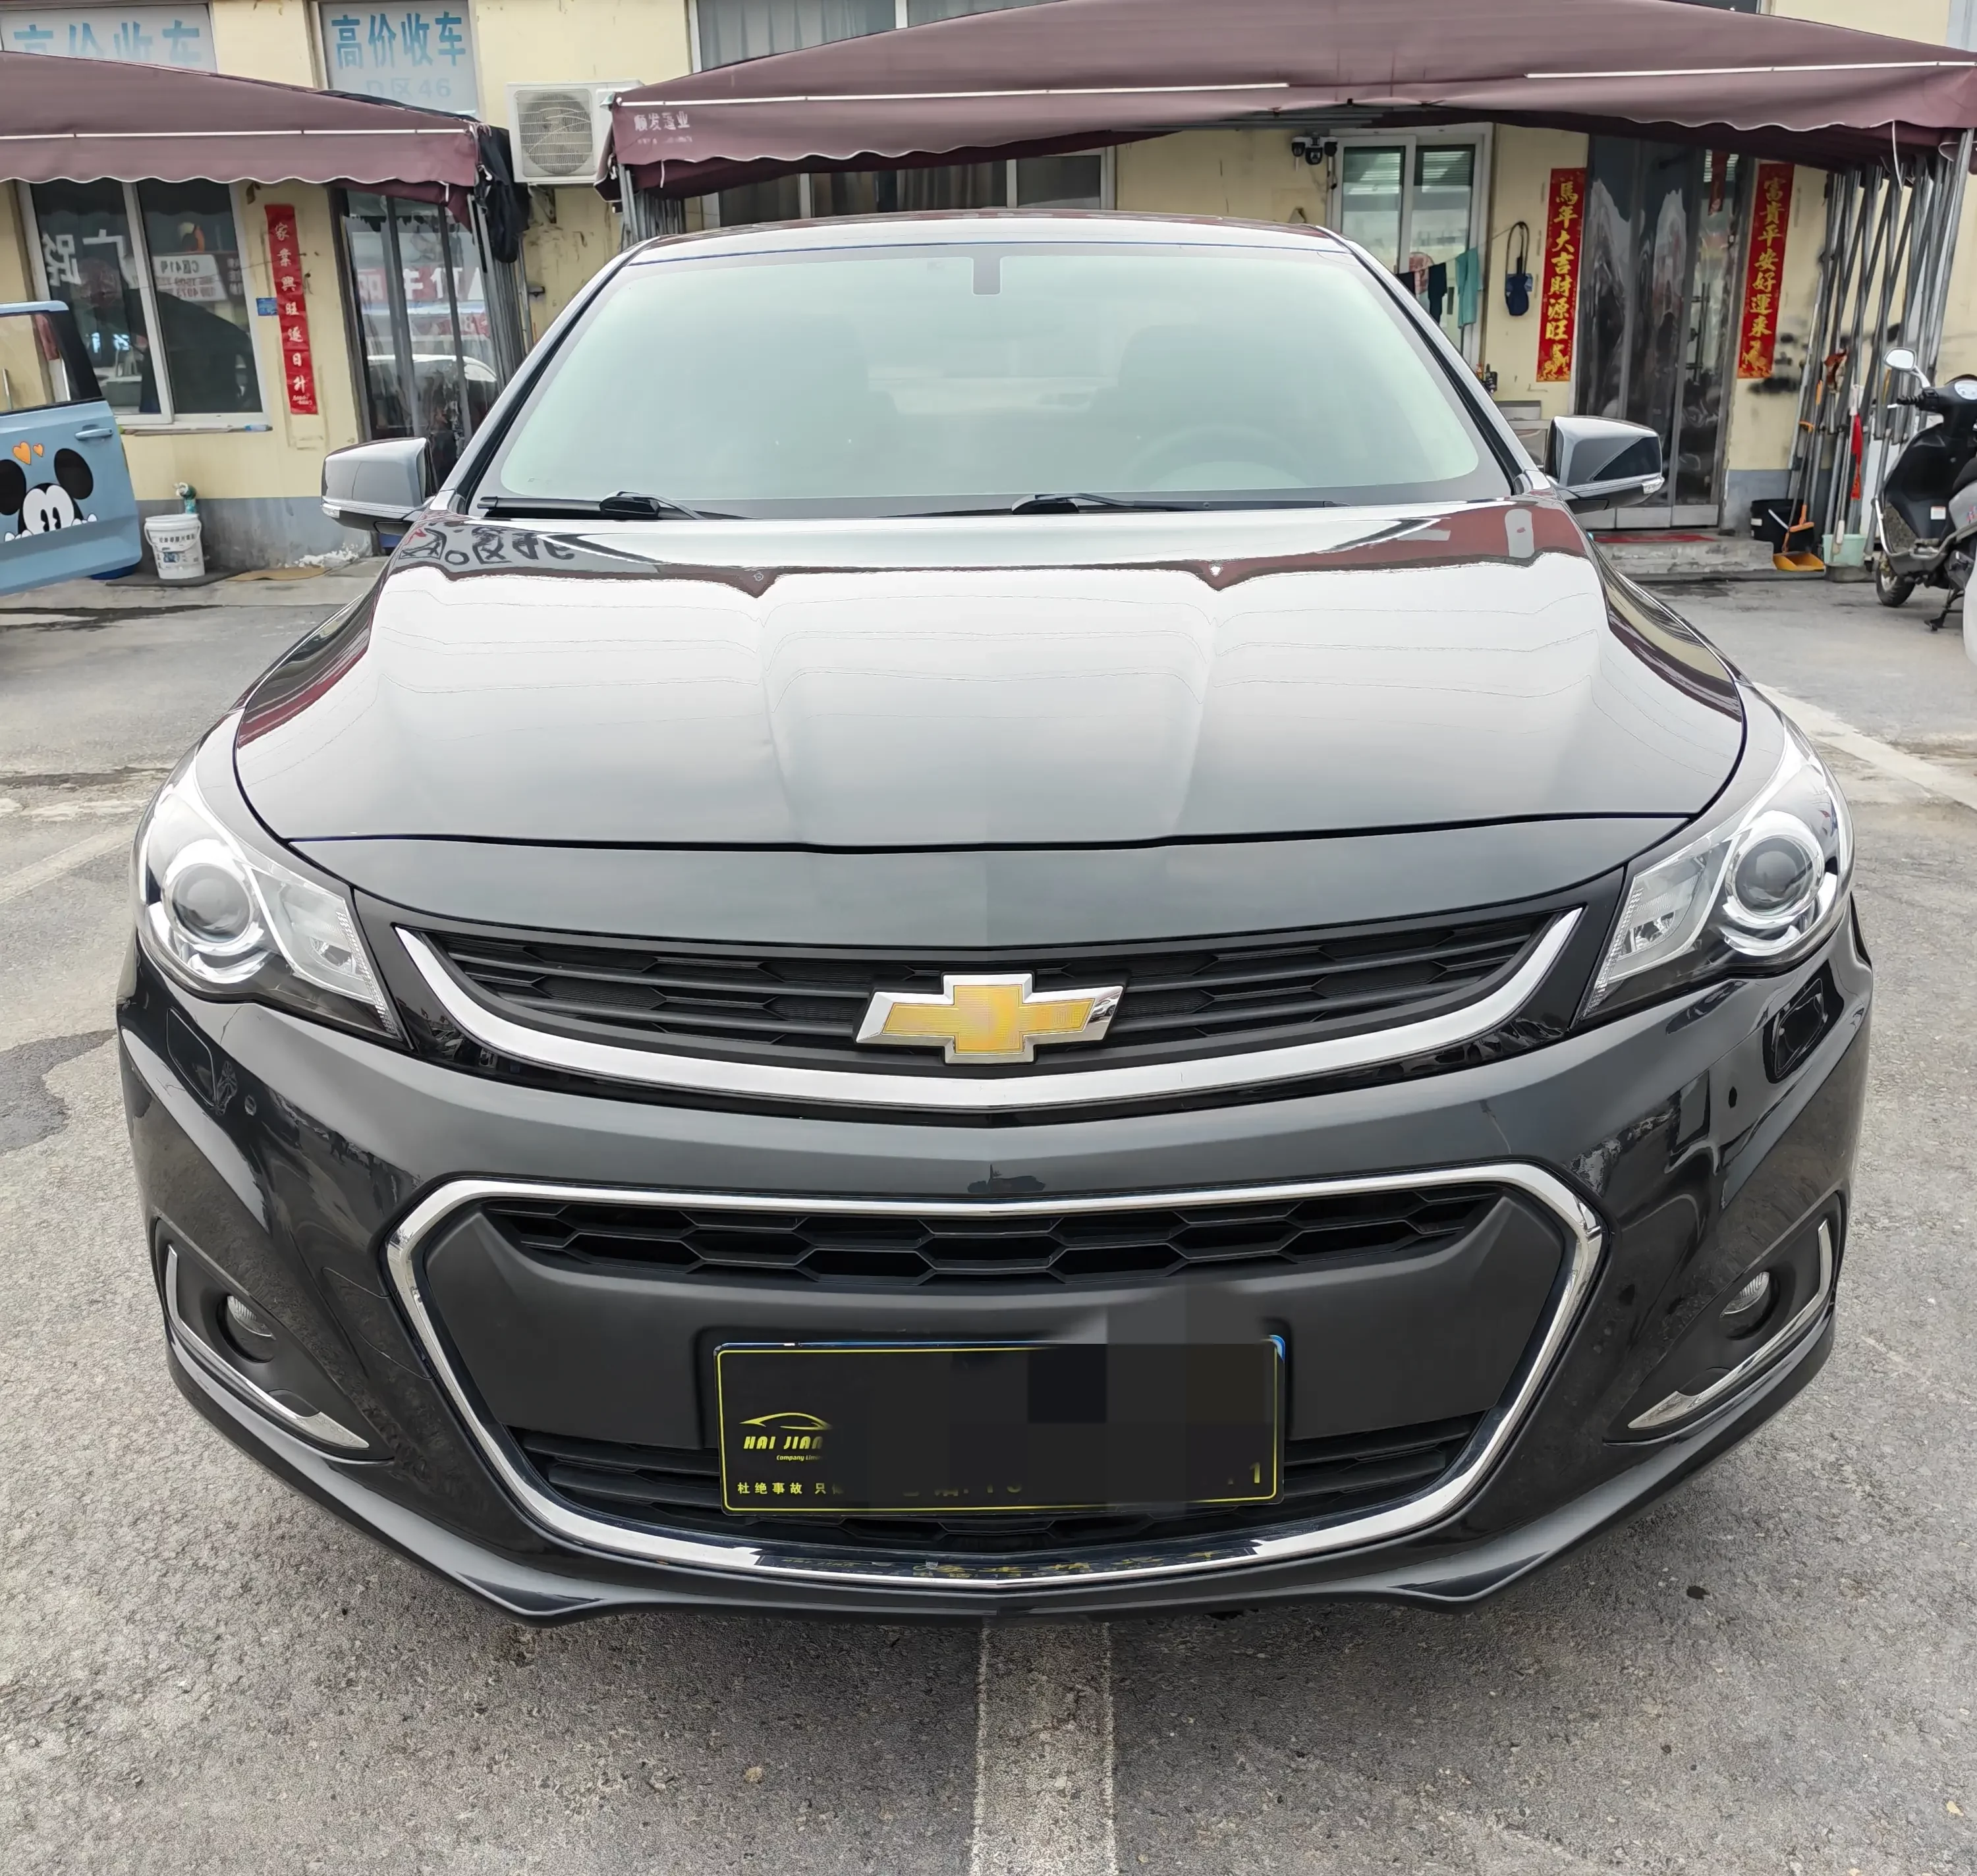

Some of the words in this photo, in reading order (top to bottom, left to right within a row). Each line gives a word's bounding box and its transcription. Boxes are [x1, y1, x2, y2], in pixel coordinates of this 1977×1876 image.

[331, 11, 465, 69] 高价收车
[743, 1436, 776, 1449] HAI
[737, 1482, 802, 1495] 杜绝事故
